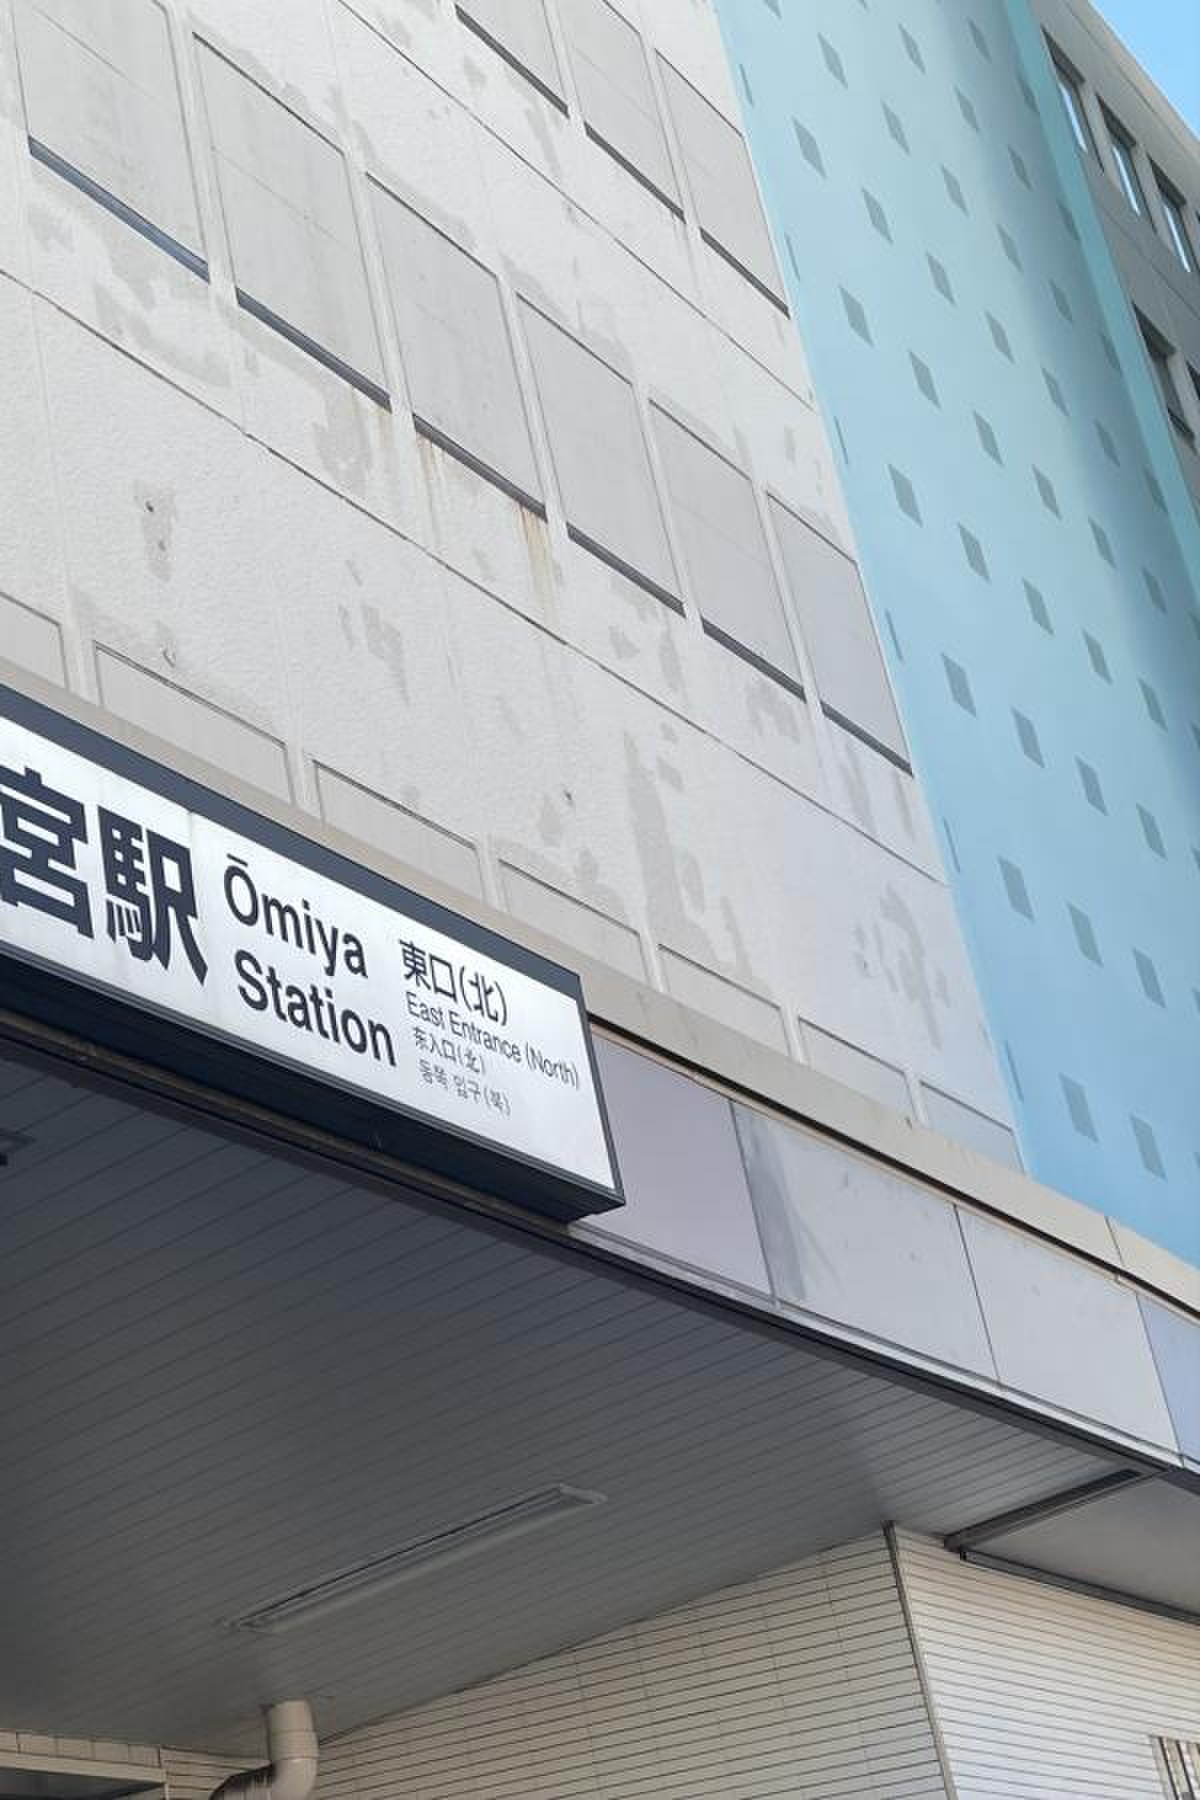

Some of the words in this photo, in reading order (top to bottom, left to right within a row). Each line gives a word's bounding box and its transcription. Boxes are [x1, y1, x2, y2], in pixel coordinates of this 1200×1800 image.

[224, 853, 368, 979] Ōmiya
[234, 949, 397, 1067] Station
[398, 939, 507, 1026] 東口(北)
[406, 991, 445, 1030] East
[448, 1009, 522, 1063] Entrance
[525, 1042, 579, 1091] (North)
